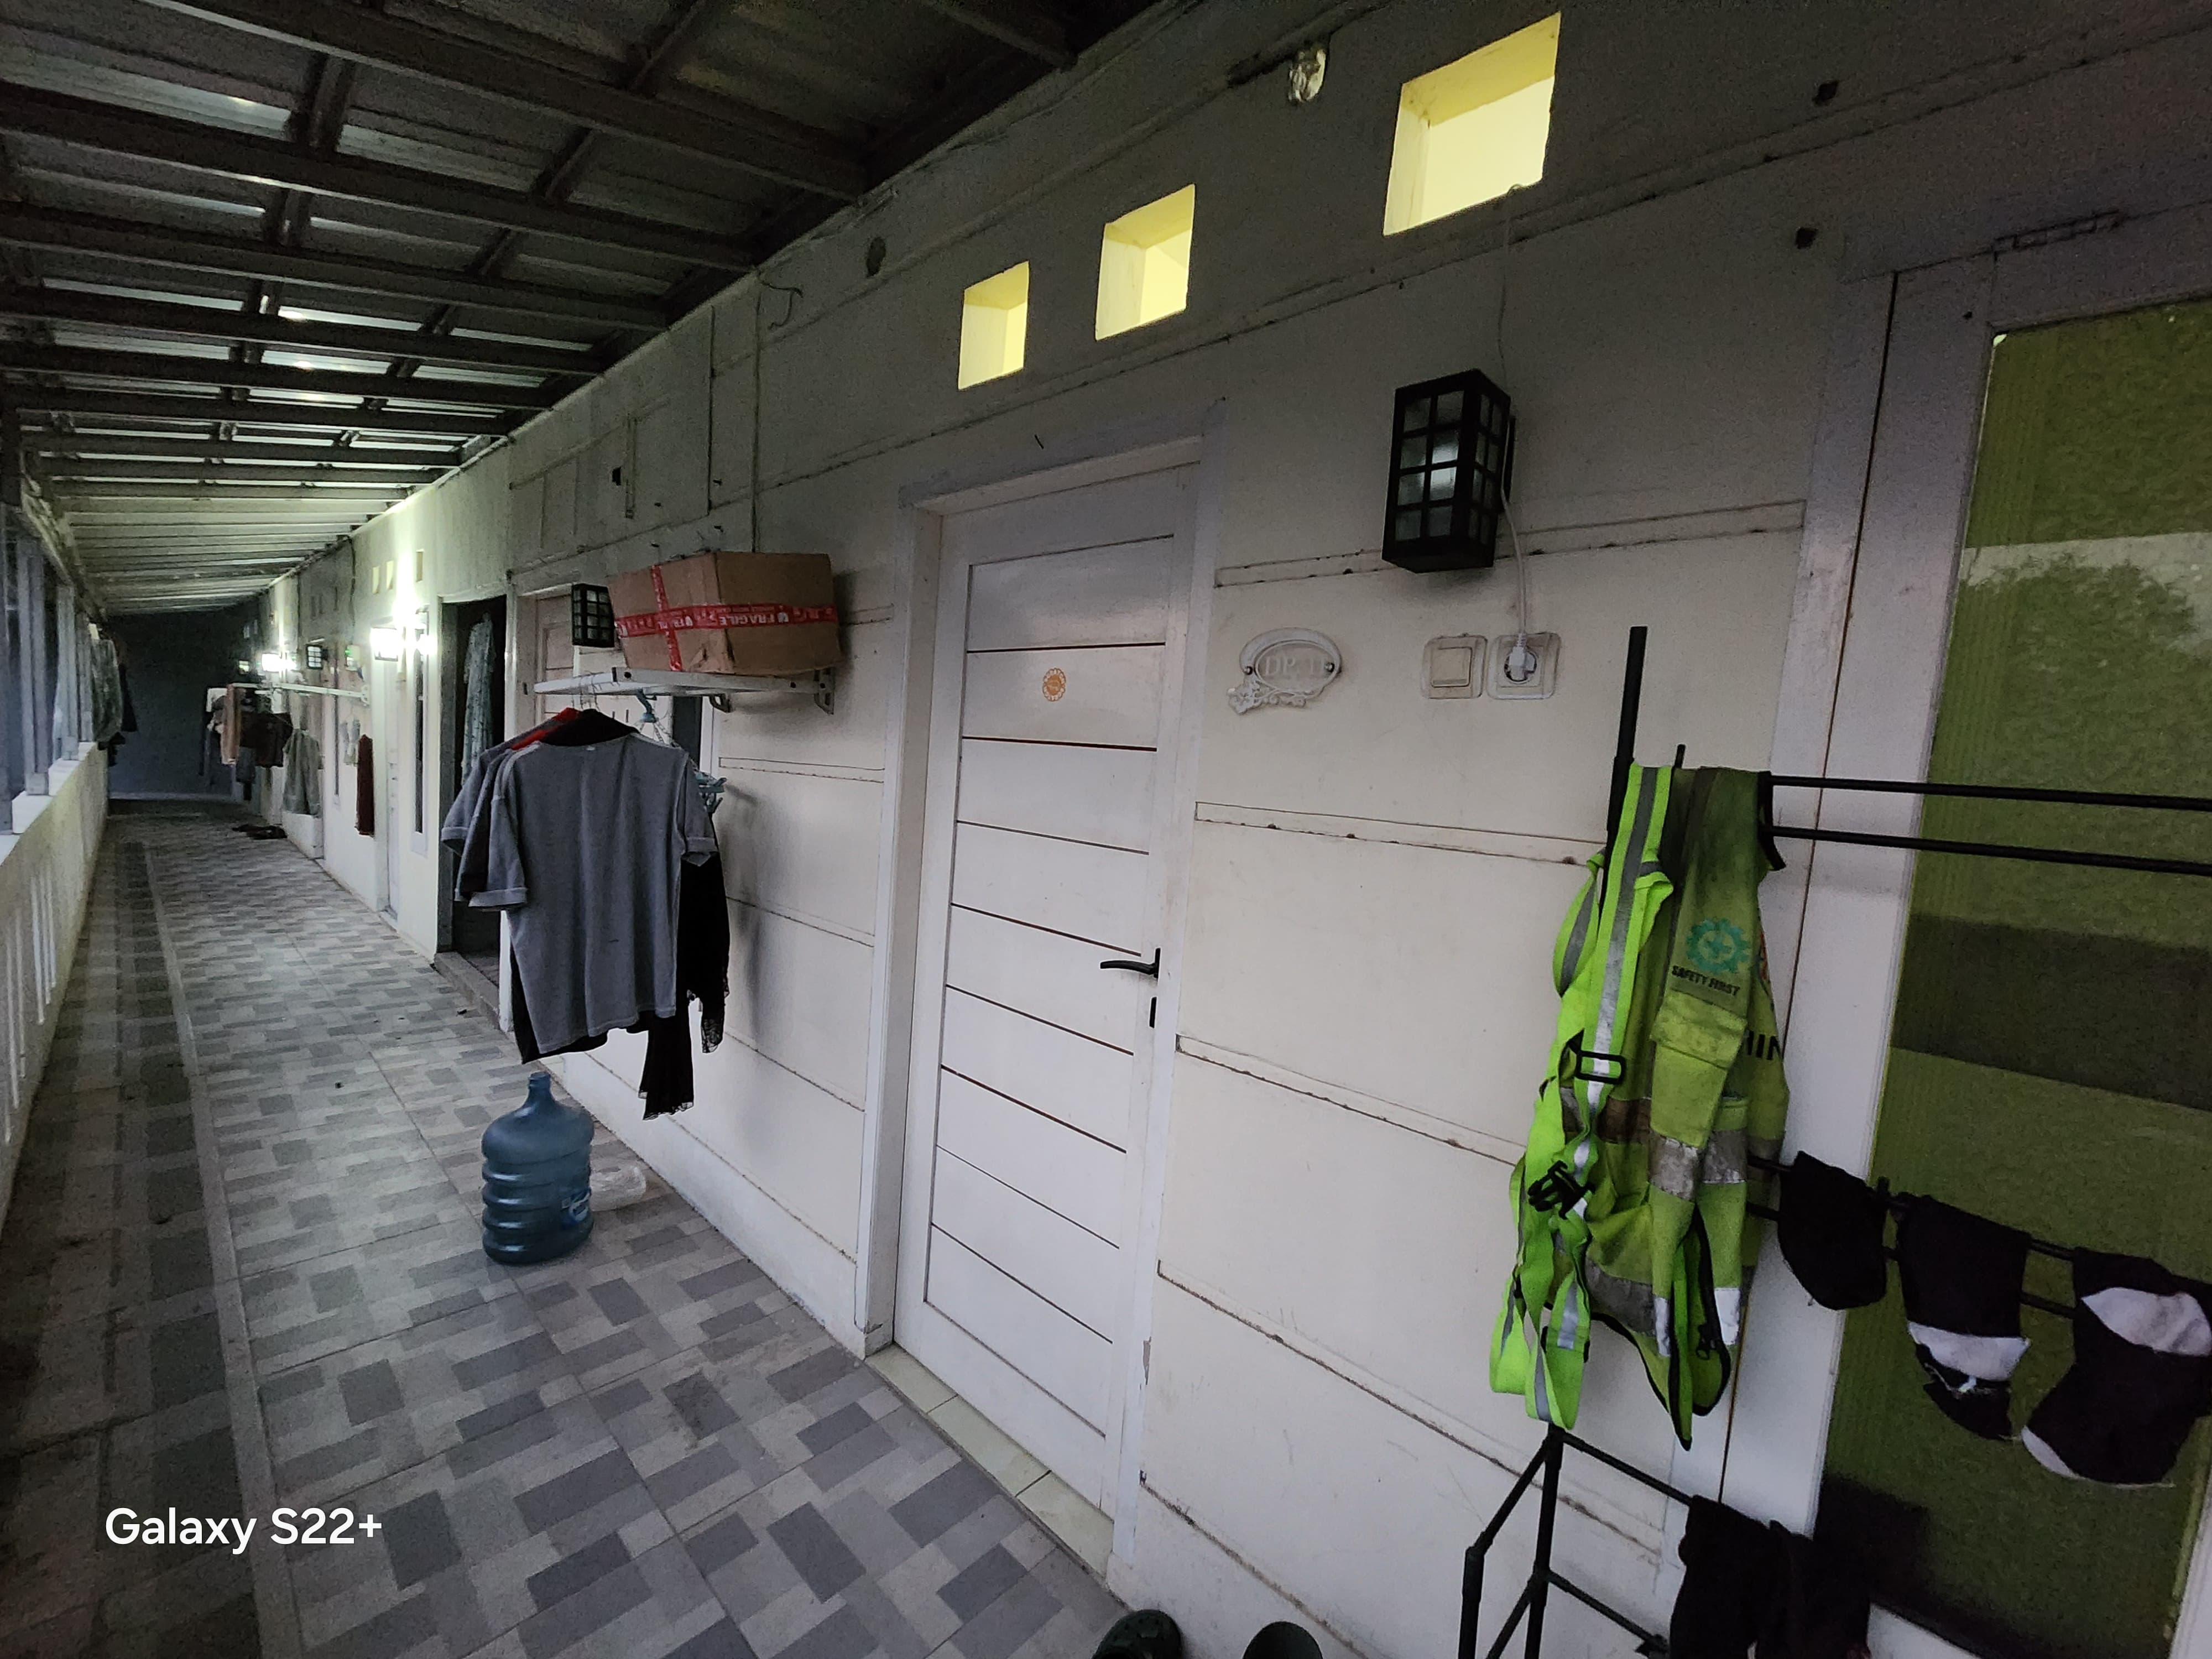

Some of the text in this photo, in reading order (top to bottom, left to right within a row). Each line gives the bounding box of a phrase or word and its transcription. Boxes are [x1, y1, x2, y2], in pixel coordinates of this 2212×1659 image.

[719, 613, 775, 625] FRAGILE
[1671, 965, 1740, 996] SAFETY FIRST
